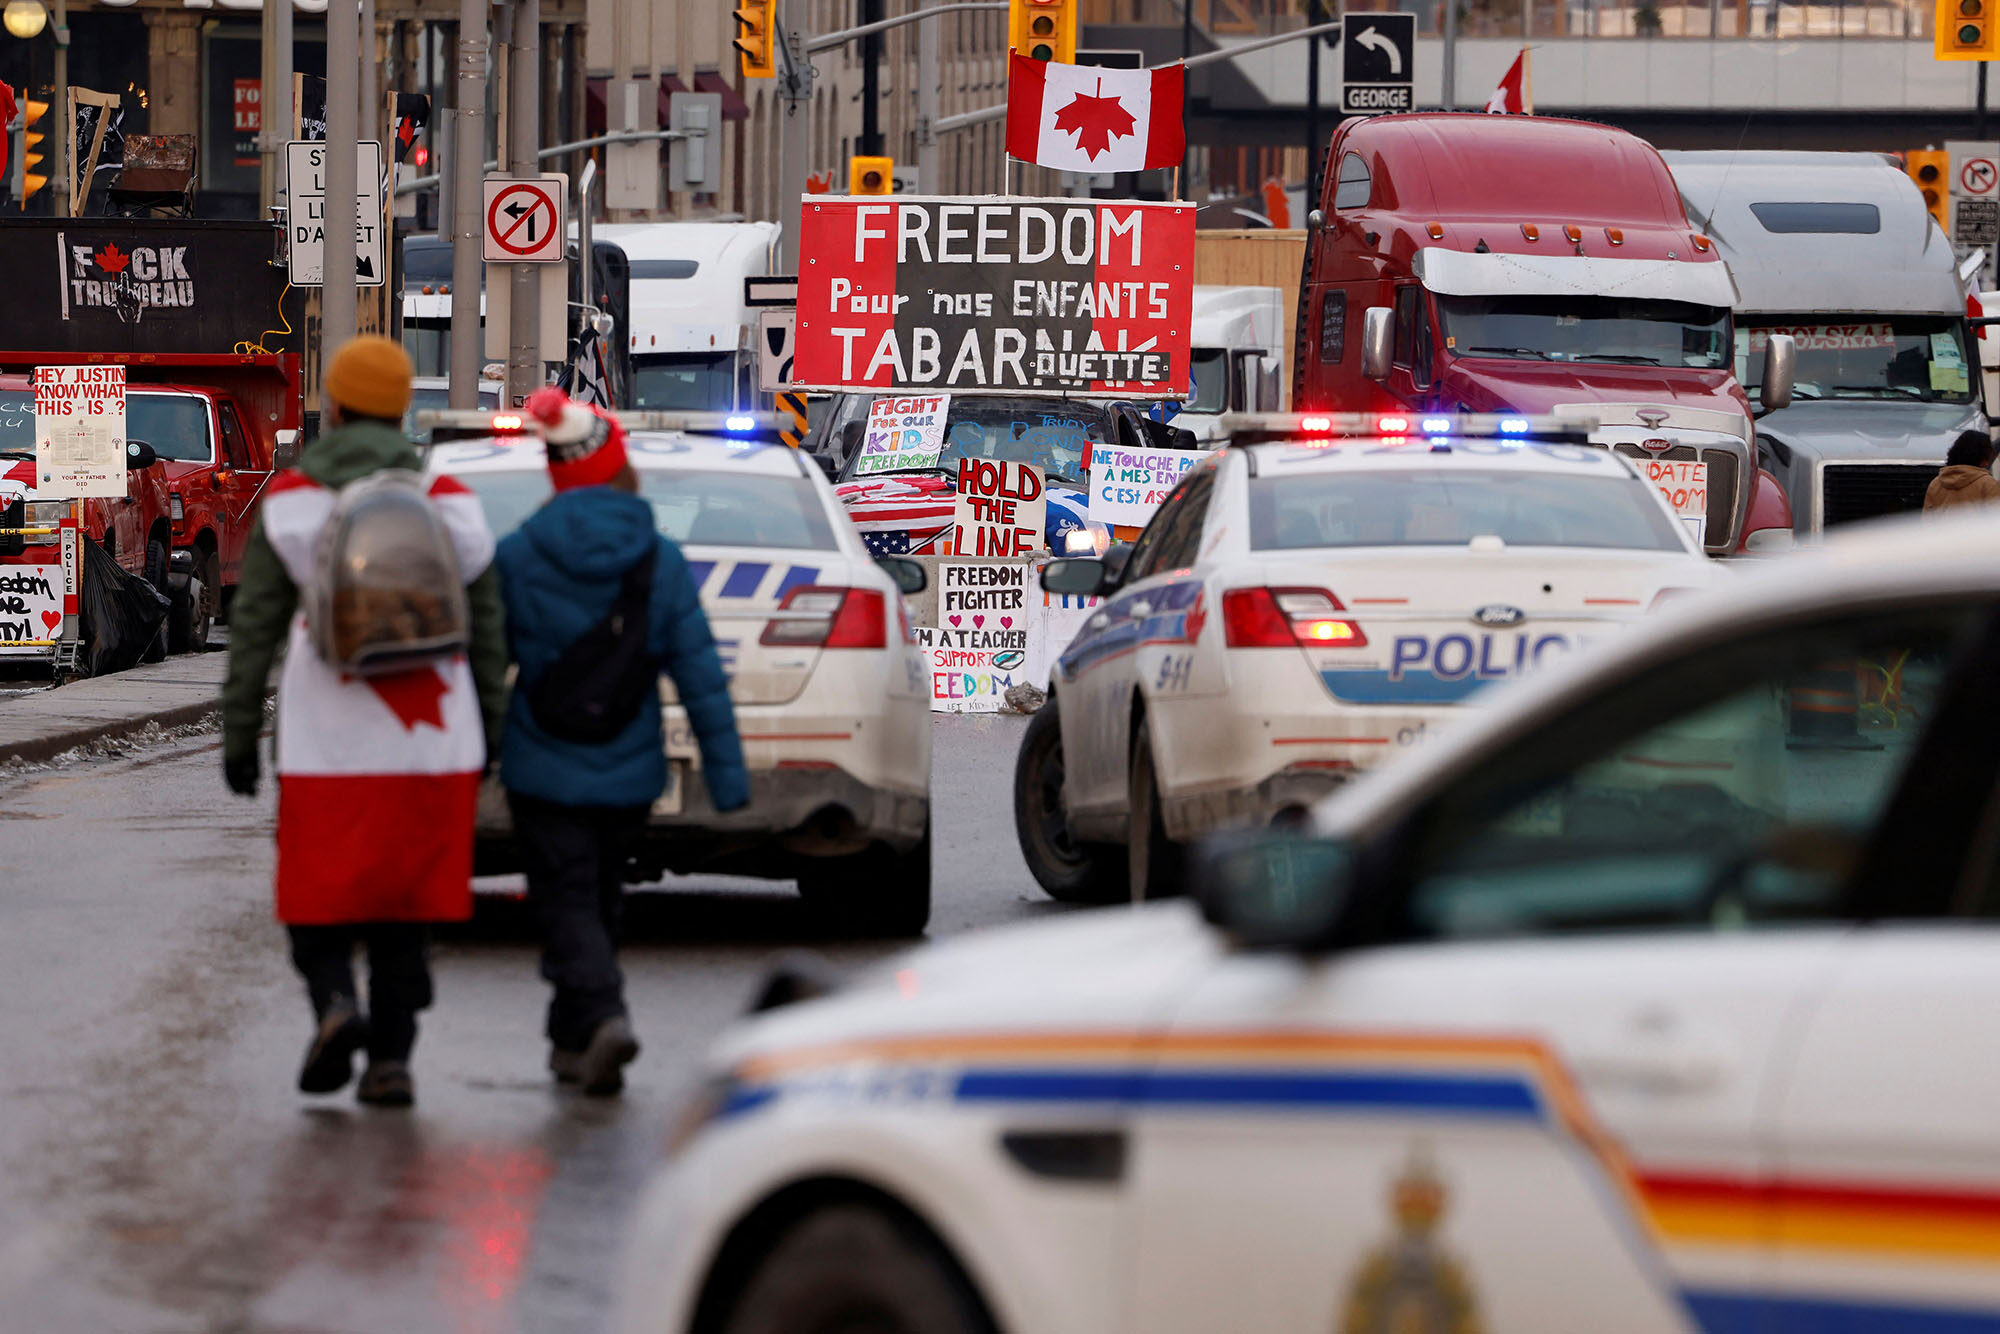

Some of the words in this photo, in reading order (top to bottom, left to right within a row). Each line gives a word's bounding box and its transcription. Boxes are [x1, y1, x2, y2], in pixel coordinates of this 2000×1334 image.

[236, 88, 261, 103] FO
[1348, 88, 1408, 107] GEORGE
[296, 222, 374, 243] D'AÊT
[855, 205, 1142, 266] FREEDOM
[72, 245, 190, 281] FCK
[830, 278, 909, 314] Pour
[933, 293, 992, 317] nos
[1013, 280, 1169, 319] ENFANTS
[35, 368, 65, 383] HEY
[74, 368, 125, 383] JUSTIN
[35, 384, 80, 399] KNOW
[82, 384, 125, 398] WHAT
[35, 400, 72, 415] THIS
[88, 400, 104, 415] IS
[871, 397, 943, 416] FIGHT
[873, 418, 898, 428] FOR
[902, 415, 934, 427] OUR
[867, 428, 942, 454] KIDS
[1008, 421, 1104, 452] DOND
[858, 453, 938, 471] FREEDOM
[1092, 450, 1112, 465] NE
[1114, 451, 1173, 472] TOUCHE
[1179, 457, 1203, 472] PA
[958, 458, 1041, 501] HOLD
[1121, 469, 1151, 484] MES
[1144, 490, 1171, 504] AS
[967, 497, 1016, 524] THE
[953, 525, 1036, 556] LINE
[65, 544, 73, 593] POLICE
[946, 566, 1023, 586] FREEDOM
[0, 572, 56, 601] edom
[946, 589, 1023, 611] FIGHTER
[914, 629, 932, 646] 'M
[939, 630, 952, 647] A
[955, 630, 1026, 649] TEACHER
[934, 649, 995, 668] SUPPORT
[1389, 632, 1570, 680] POLIC
[934, 671, 1014, 699] EEDOM
